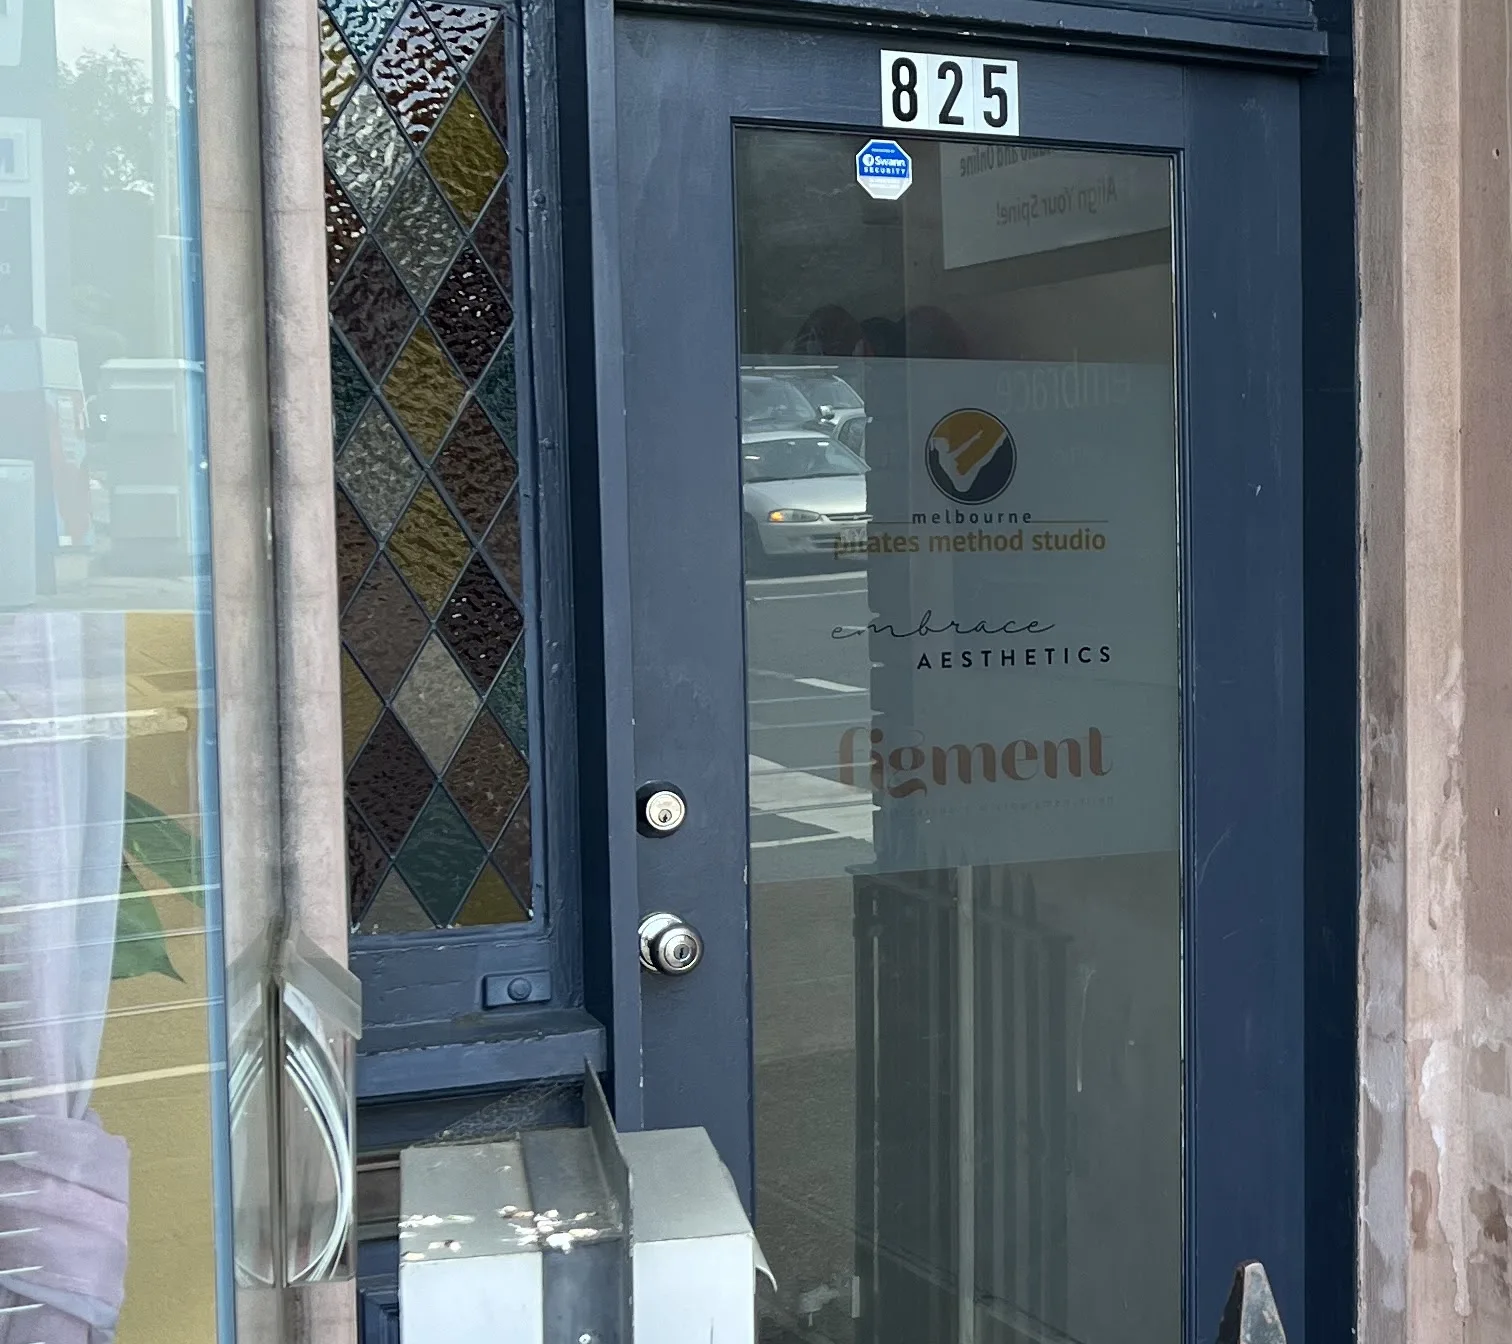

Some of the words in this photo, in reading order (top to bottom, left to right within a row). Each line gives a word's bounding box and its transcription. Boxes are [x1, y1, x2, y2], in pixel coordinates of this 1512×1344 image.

[890, 56, 1009, 129] 825
[863, 166, 906, 176] SECURITY
[874, 155, 907, 168] Swann
[912, 509, 1032, 525] melbourne
[929, 526, 1023, 553] method
[1031, 527, 1107, 552] studio
[831, 609, 1056, 641] embrace
[917, 646, 1112, 670] AESTHETICS
[836, 725, 1114, 799] figment
